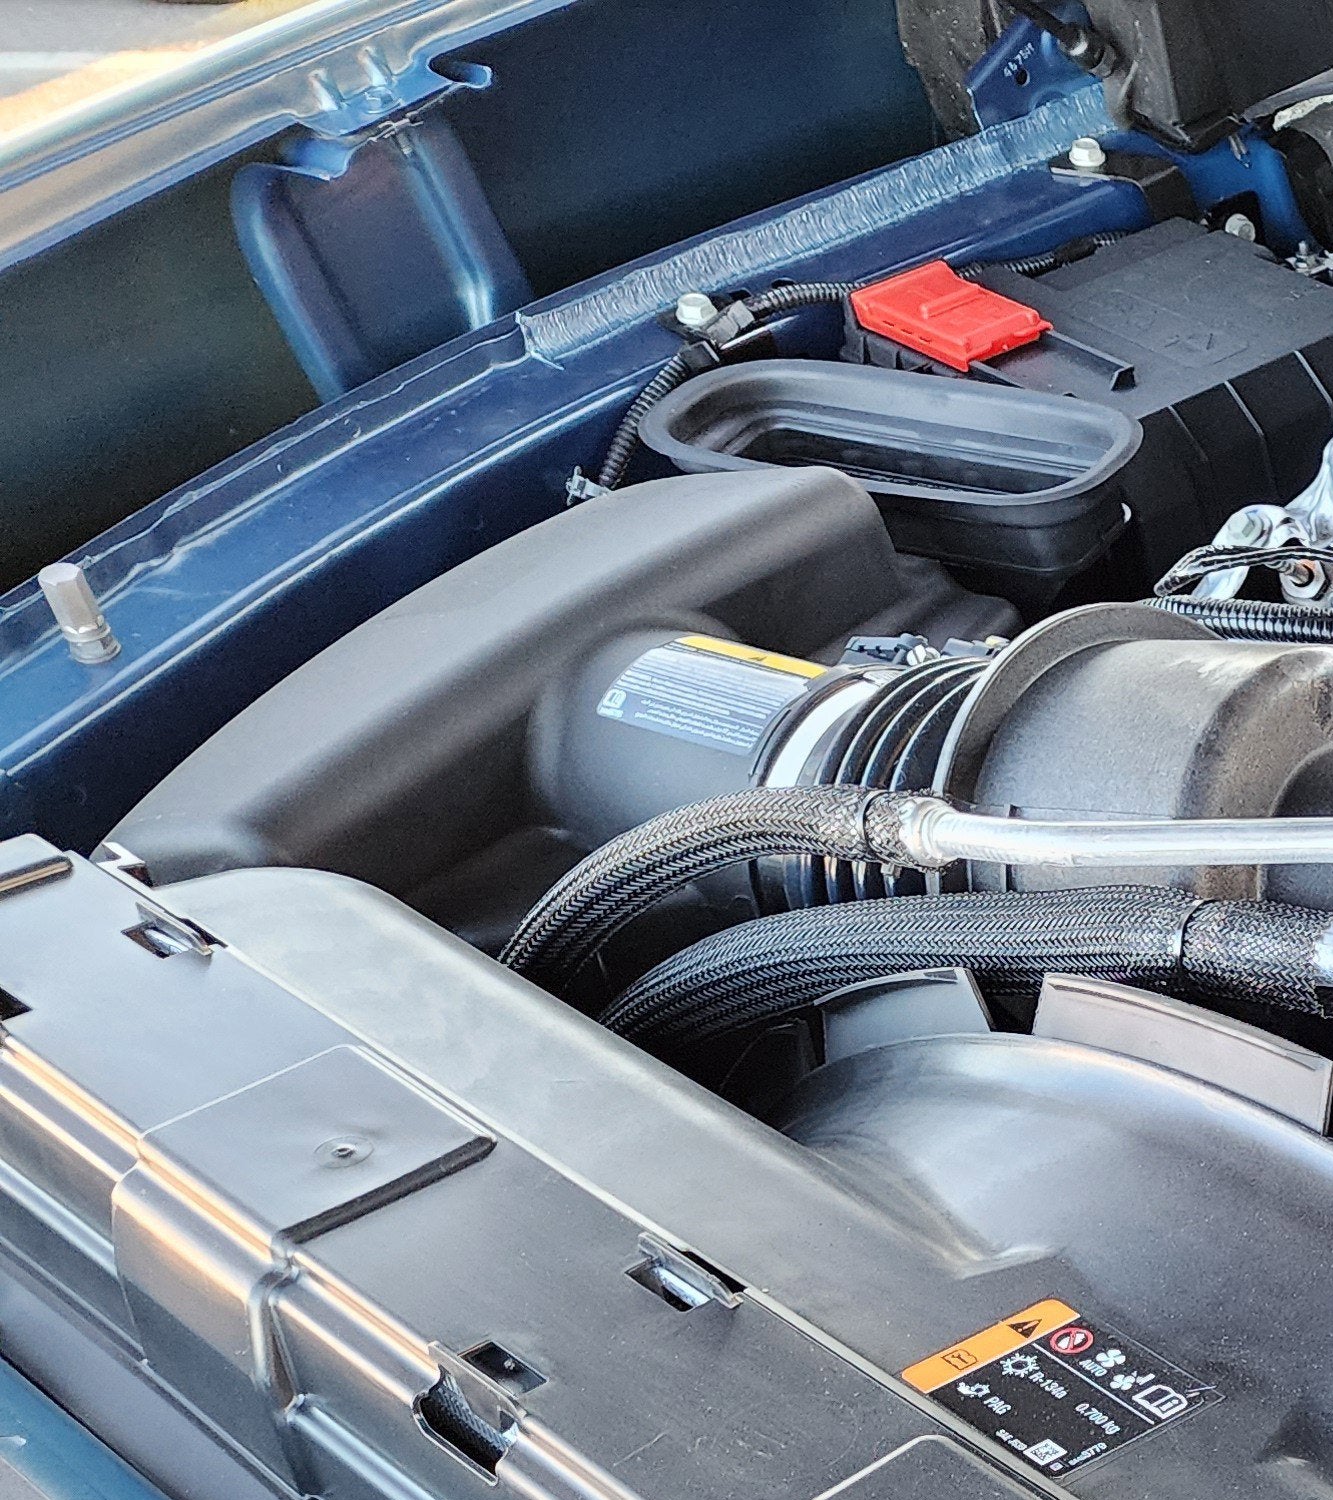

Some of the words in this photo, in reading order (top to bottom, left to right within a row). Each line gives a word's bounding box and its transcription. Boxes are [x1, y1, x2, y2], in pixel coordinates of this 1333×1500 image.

[1079, 1359, 1106, 1377] AUTO
[983, 1395, 1012, 1415] PAG
[1029, 1370, 1068, 1400] R-134a
[1075, 1402, 1107, 1425] 0.700
[1105, 1419, 1120, 1435] kg
